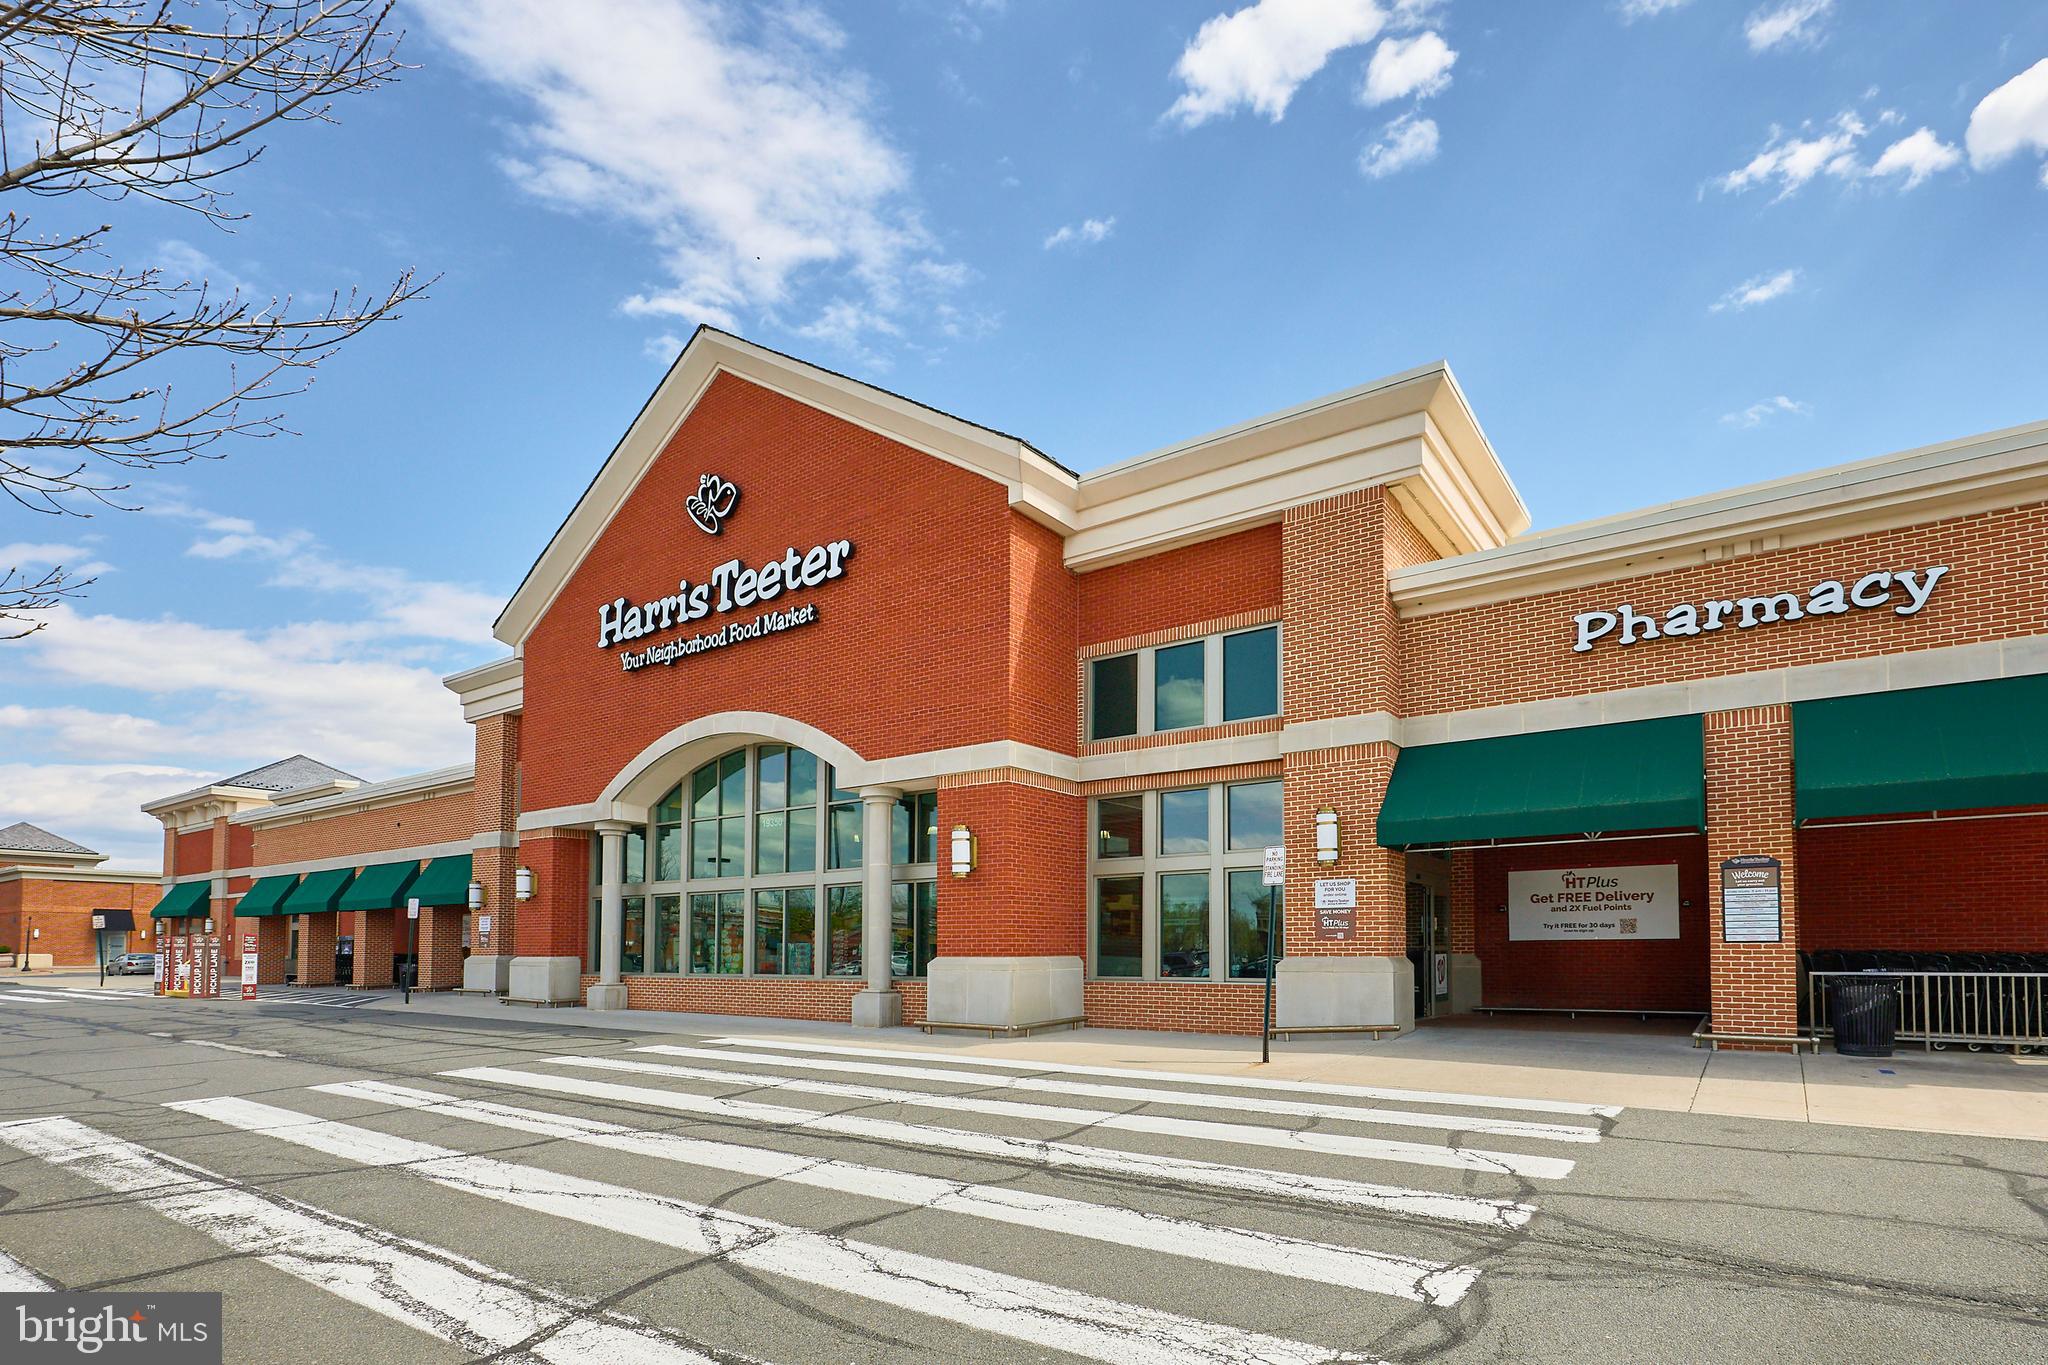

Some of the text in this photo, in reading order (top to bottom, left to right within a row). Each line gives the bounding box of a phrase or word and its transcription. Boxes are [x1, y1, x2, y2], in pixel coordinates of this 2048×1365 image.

[597, 539, 851, 649] Harris Teeter
[1572, 565, 1950, 652] Pharmacy
[620, 603, 815, 671] Your Neighborhood Food Market
[1565, 876, 1619, 889] HT Plus
[1731, 869, 1769, 880] Welcome
[1530, 890, 1655, 904] Get FREE Delivery
[1582, 904, 1602, 912] Fuel
[1603, 903, 1632, 911] Points
[175, 949, 183, 967] LANE
[194, 949, 202, 967] LANE
[210, 949, 218, 967] LANE
[193, 968, 202, 994] PICKUP
[210, 968, 218, 994] PICKUP
